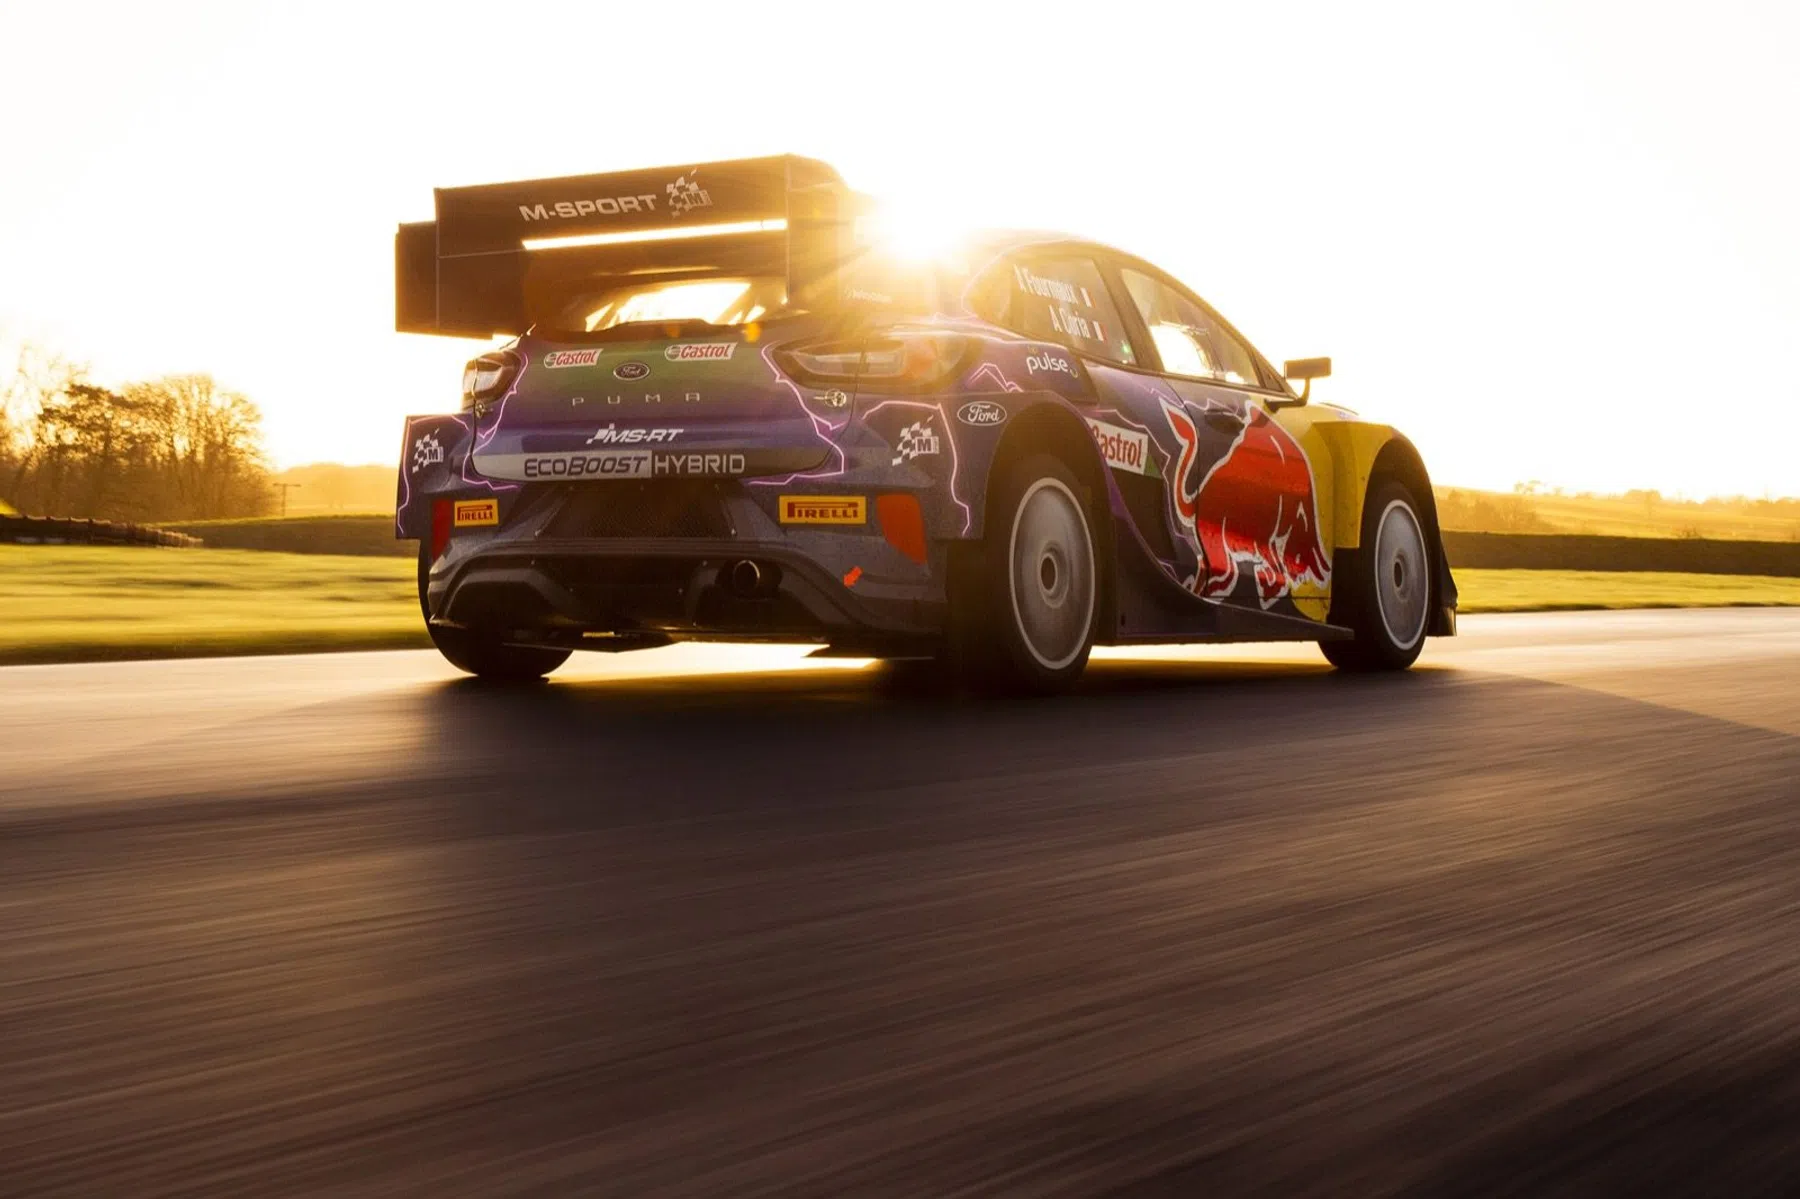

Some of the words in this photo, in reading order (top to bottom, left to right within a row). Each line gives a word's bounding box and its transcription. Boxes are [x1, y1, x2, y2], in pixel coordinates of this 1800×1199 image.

[519, 194, 657, 221] M-SPORT
[555, 350, 596, 366] Castrol
[681, 343, 730, 359] Castrol
[1026, 352, 1069, 375] pulse
[967, 404, 1000, 423] Ford
[655, 454, 745, 475] HYBRID
[457, 504, 494, 521] PIRELLI
[787, 502, 859, 519] PIRELLI
